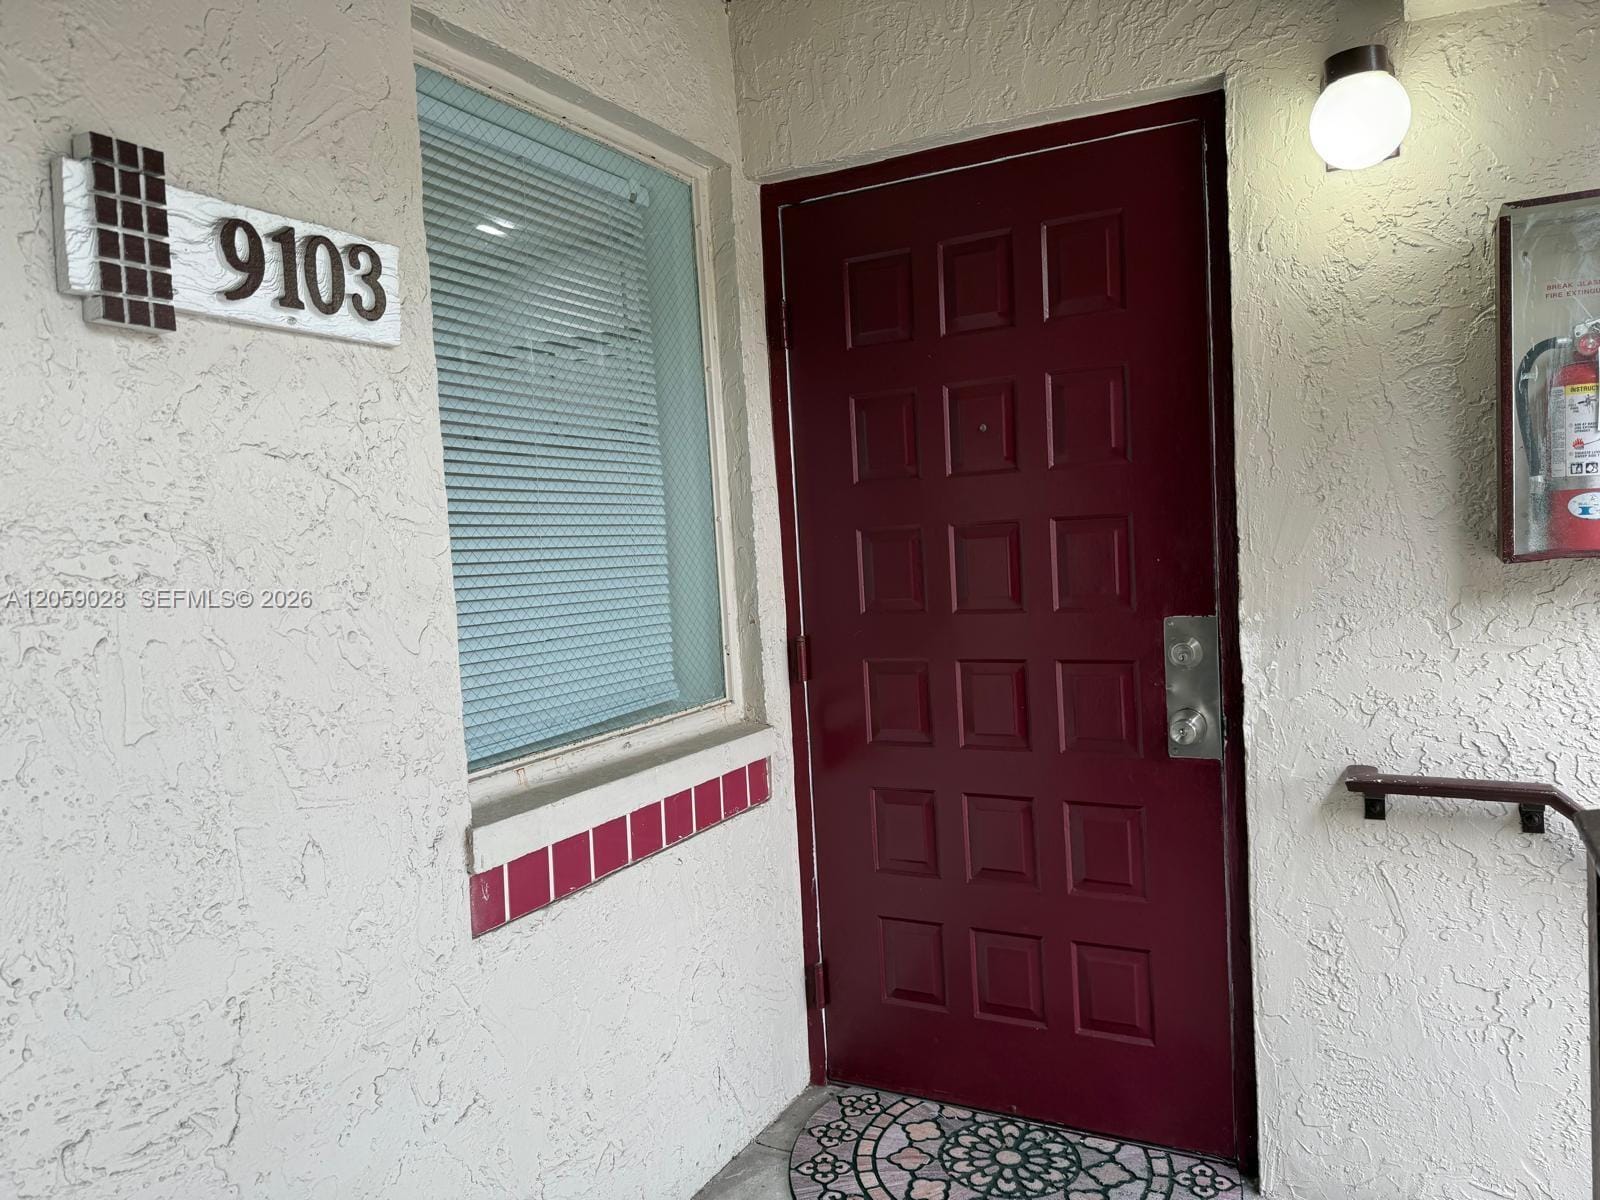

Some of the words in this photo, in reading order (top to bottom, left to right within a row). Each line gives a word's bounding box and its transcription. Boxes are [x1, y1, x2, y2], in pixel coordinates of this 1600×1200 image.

[217, 217, 387, 322] 9103
[1546, 282, 1574, 291] BREAK
[1545, 291, 1564, 300] FIRE
